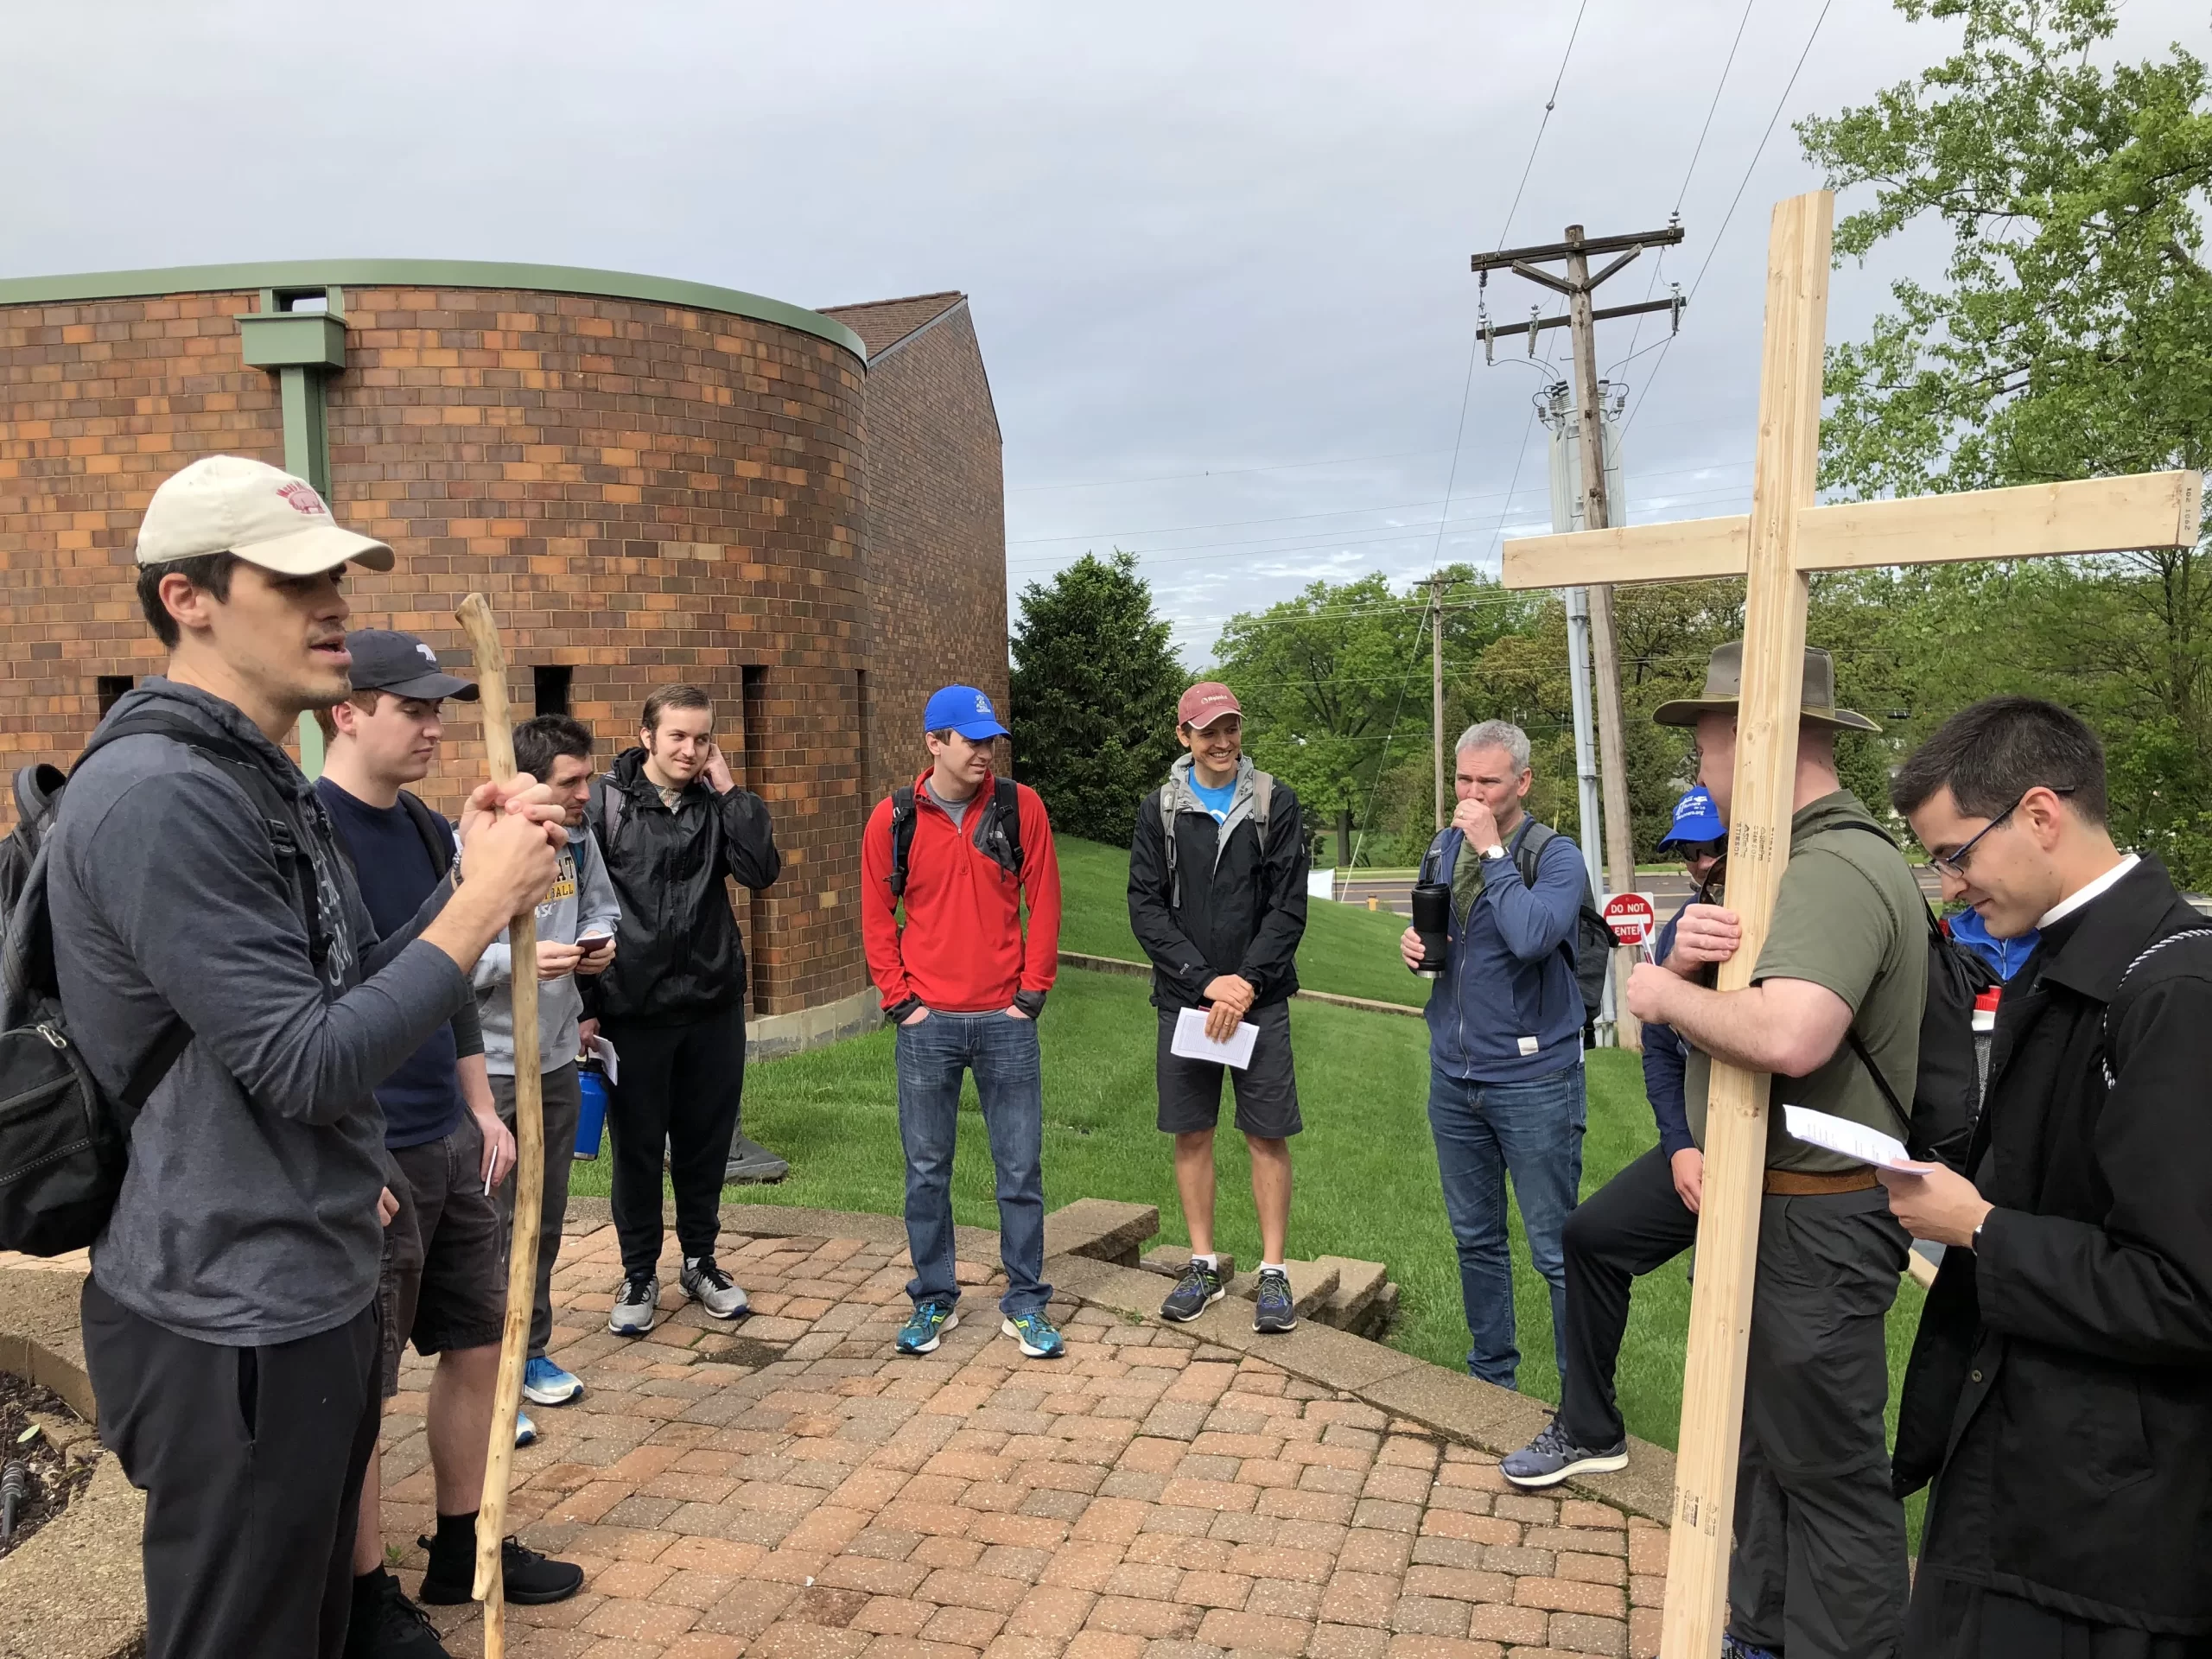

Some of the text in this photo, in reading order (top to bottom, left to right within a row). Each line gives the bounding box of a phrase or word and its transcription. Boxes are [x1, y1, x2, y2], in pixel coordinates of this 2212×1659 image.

[556, 857, 574, 882] AT
[544, 884, 574, 900] BALL
[1611, 903, 1645, 914] DO NOT
